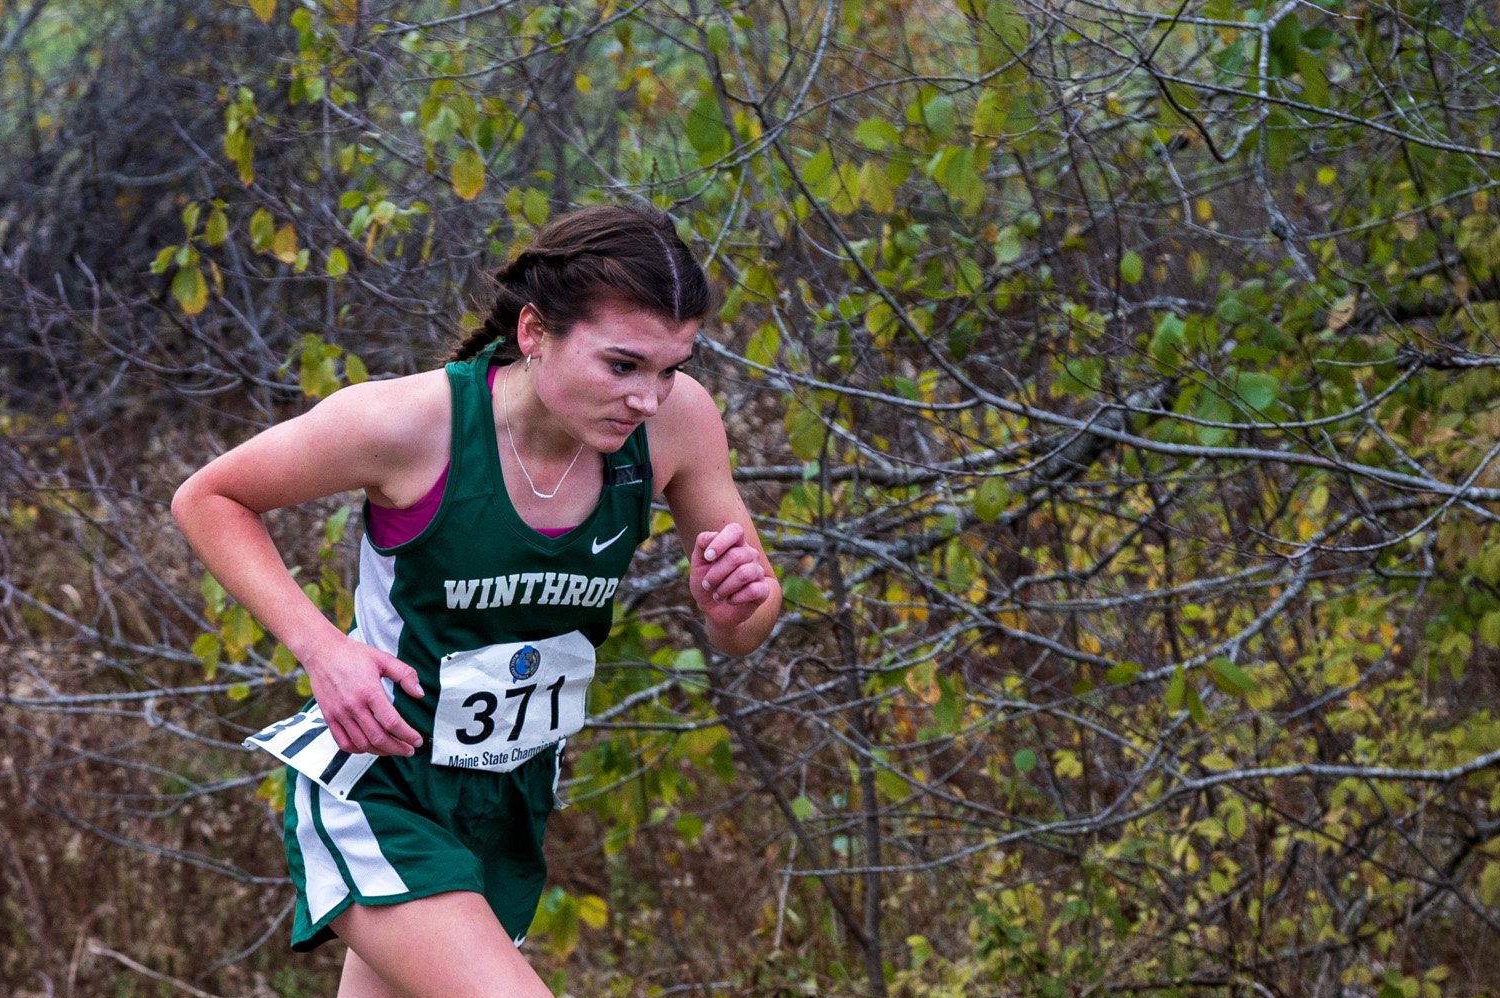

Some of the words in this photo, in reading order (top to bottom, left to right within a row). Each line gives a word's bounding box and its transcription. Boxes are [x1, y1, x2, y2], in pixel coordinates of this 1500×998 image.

[443, 571, 619, 610] WINTHROP
[455, 675, 566, 746] 371
[448, 754, 479, 768] Maine
[482, 751, 509, 766] State
